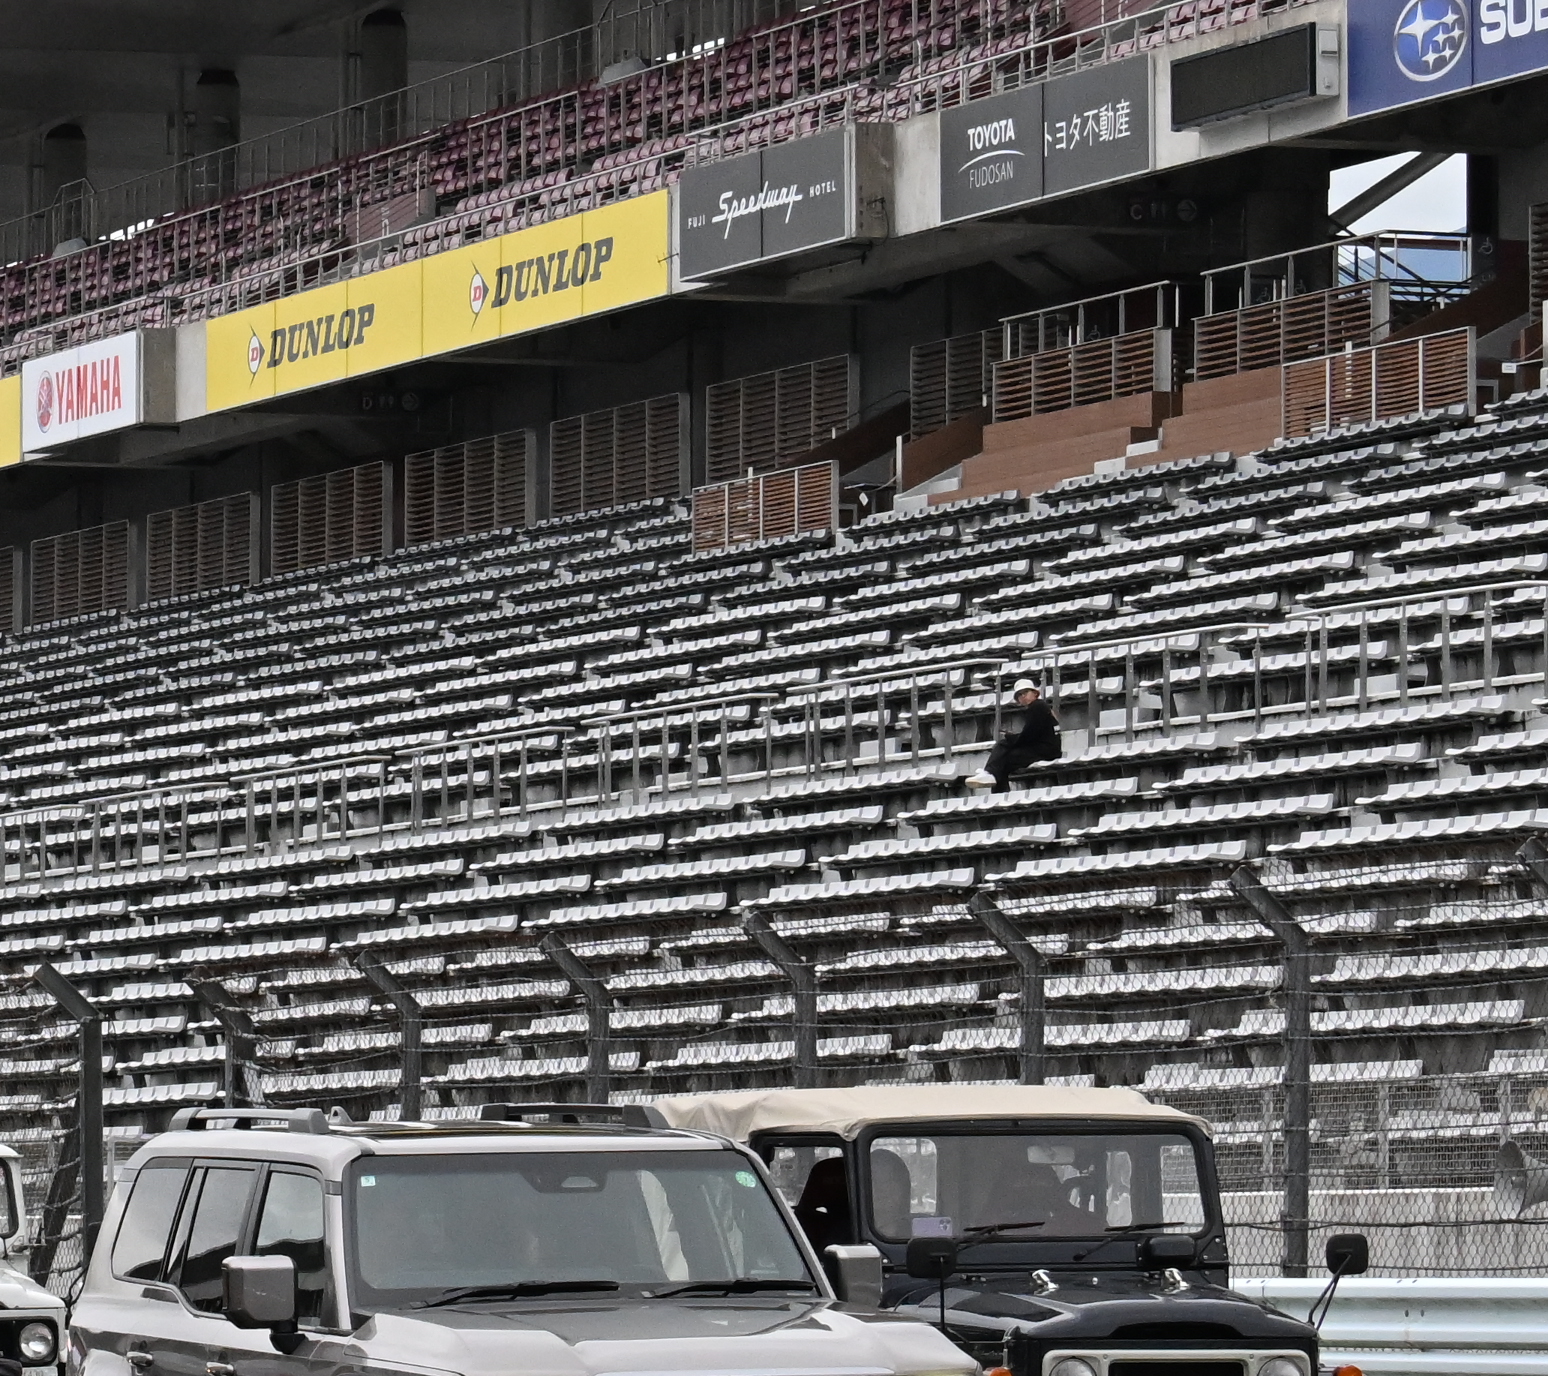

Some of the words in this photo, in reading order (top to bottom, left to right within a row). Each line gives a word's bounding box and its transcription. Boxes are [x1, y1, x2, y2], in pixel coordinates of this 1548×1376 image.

[967, 118, 1015, 150] TOYOTA
[1043, 99, 1131, 157] トヨタ不動産
[969, 160, 1013, 189] FUDOSAN
[688, 216, 705, 229] FUJI
[711, 180, 803, 239] Speedway
[809, 181, 836, 198] HOTEL
[491, 237, 614, 308] DUNLOP
[267, 303, 375, 368] DUNLOP
[55, 355, 121, 425] YAMAHA
